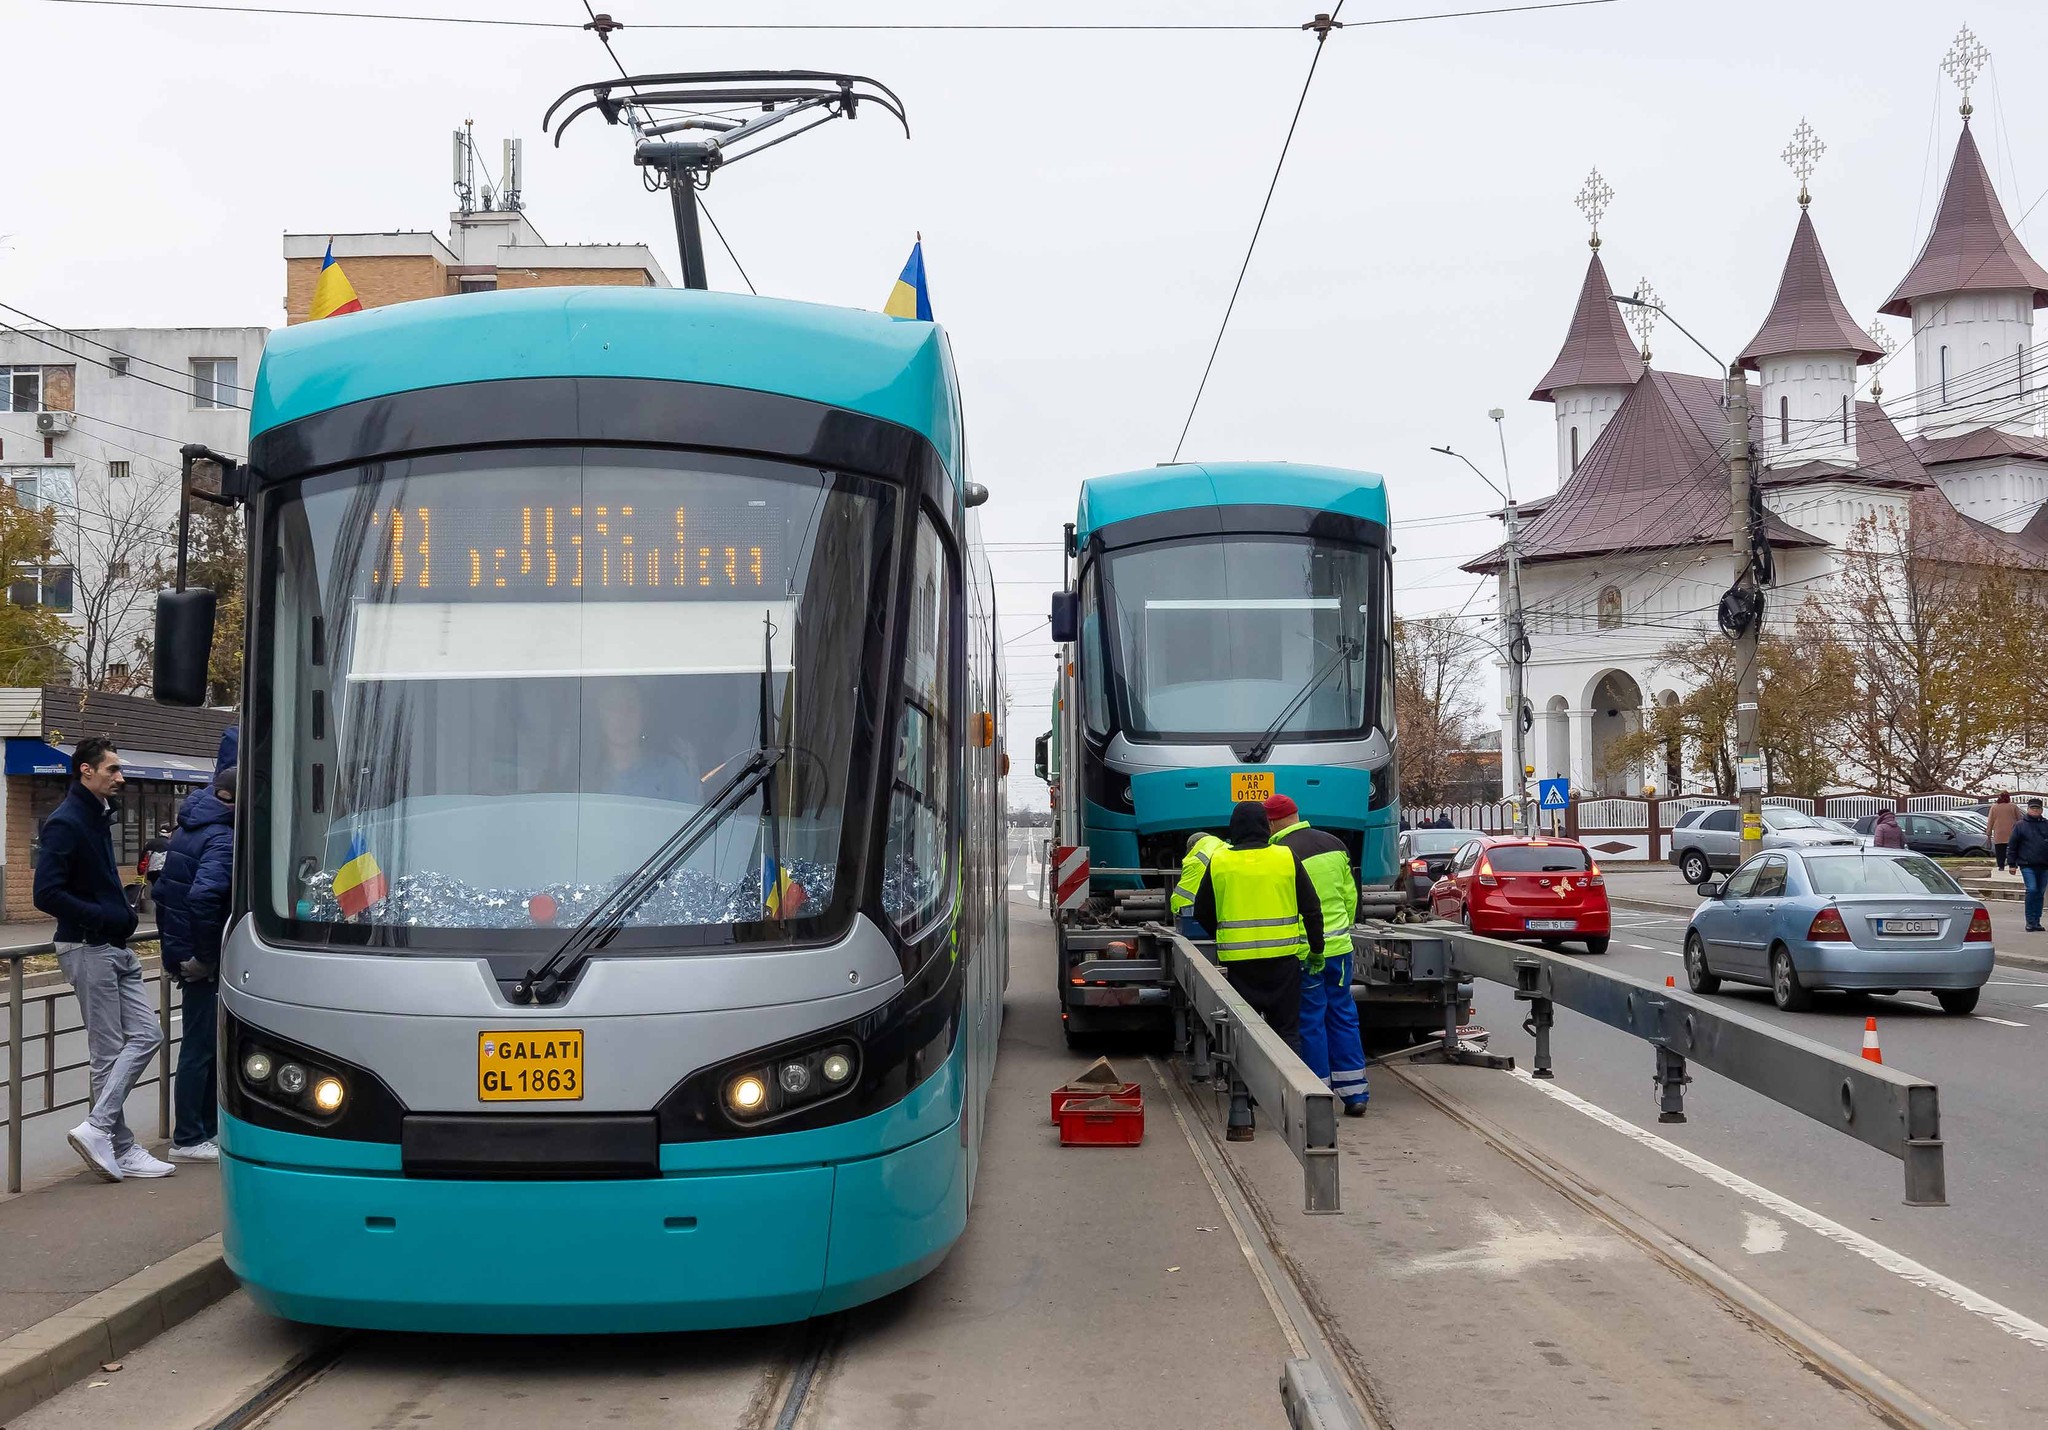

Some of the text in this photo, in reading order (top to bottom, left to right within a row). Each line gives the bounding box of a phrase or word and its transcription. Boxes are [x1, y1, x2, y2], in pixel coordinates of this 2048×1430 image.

[1237, 790, 1269, 800] 01379
[498, 1041, 579, 1060] GALATI
[483, 1069, 577, 1092] GL 1863
